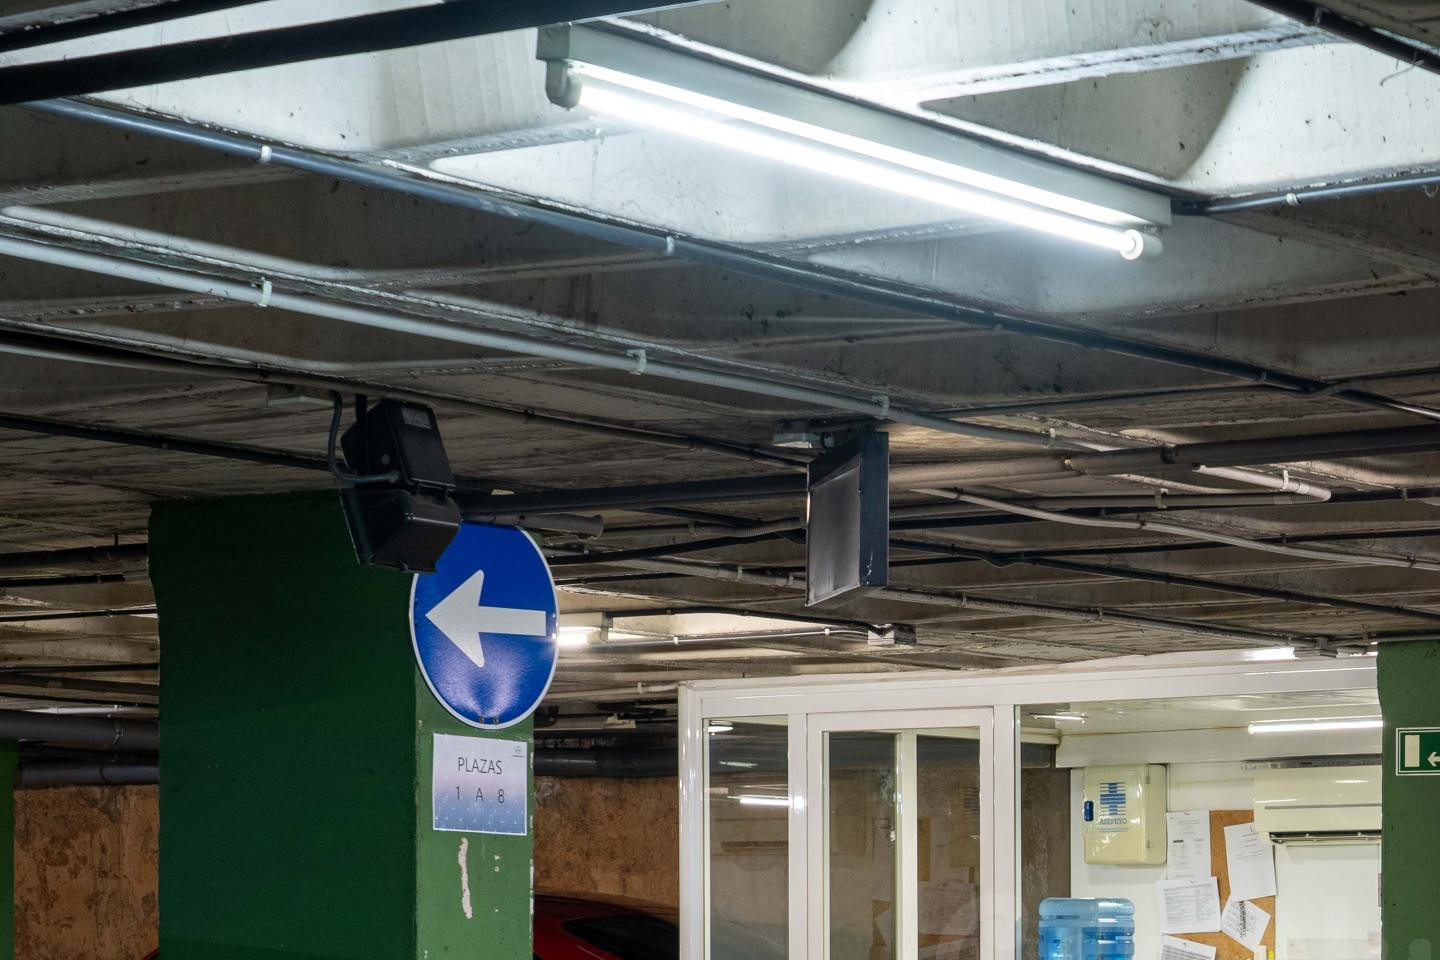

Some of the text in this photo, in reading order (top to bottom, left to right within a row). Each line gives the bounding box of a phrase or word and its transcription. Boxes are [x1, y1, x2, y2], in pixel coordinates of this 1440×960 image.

[458, 756, 503, 775] PLAZAS
[455, 785, 505, 804] 1 A 8
